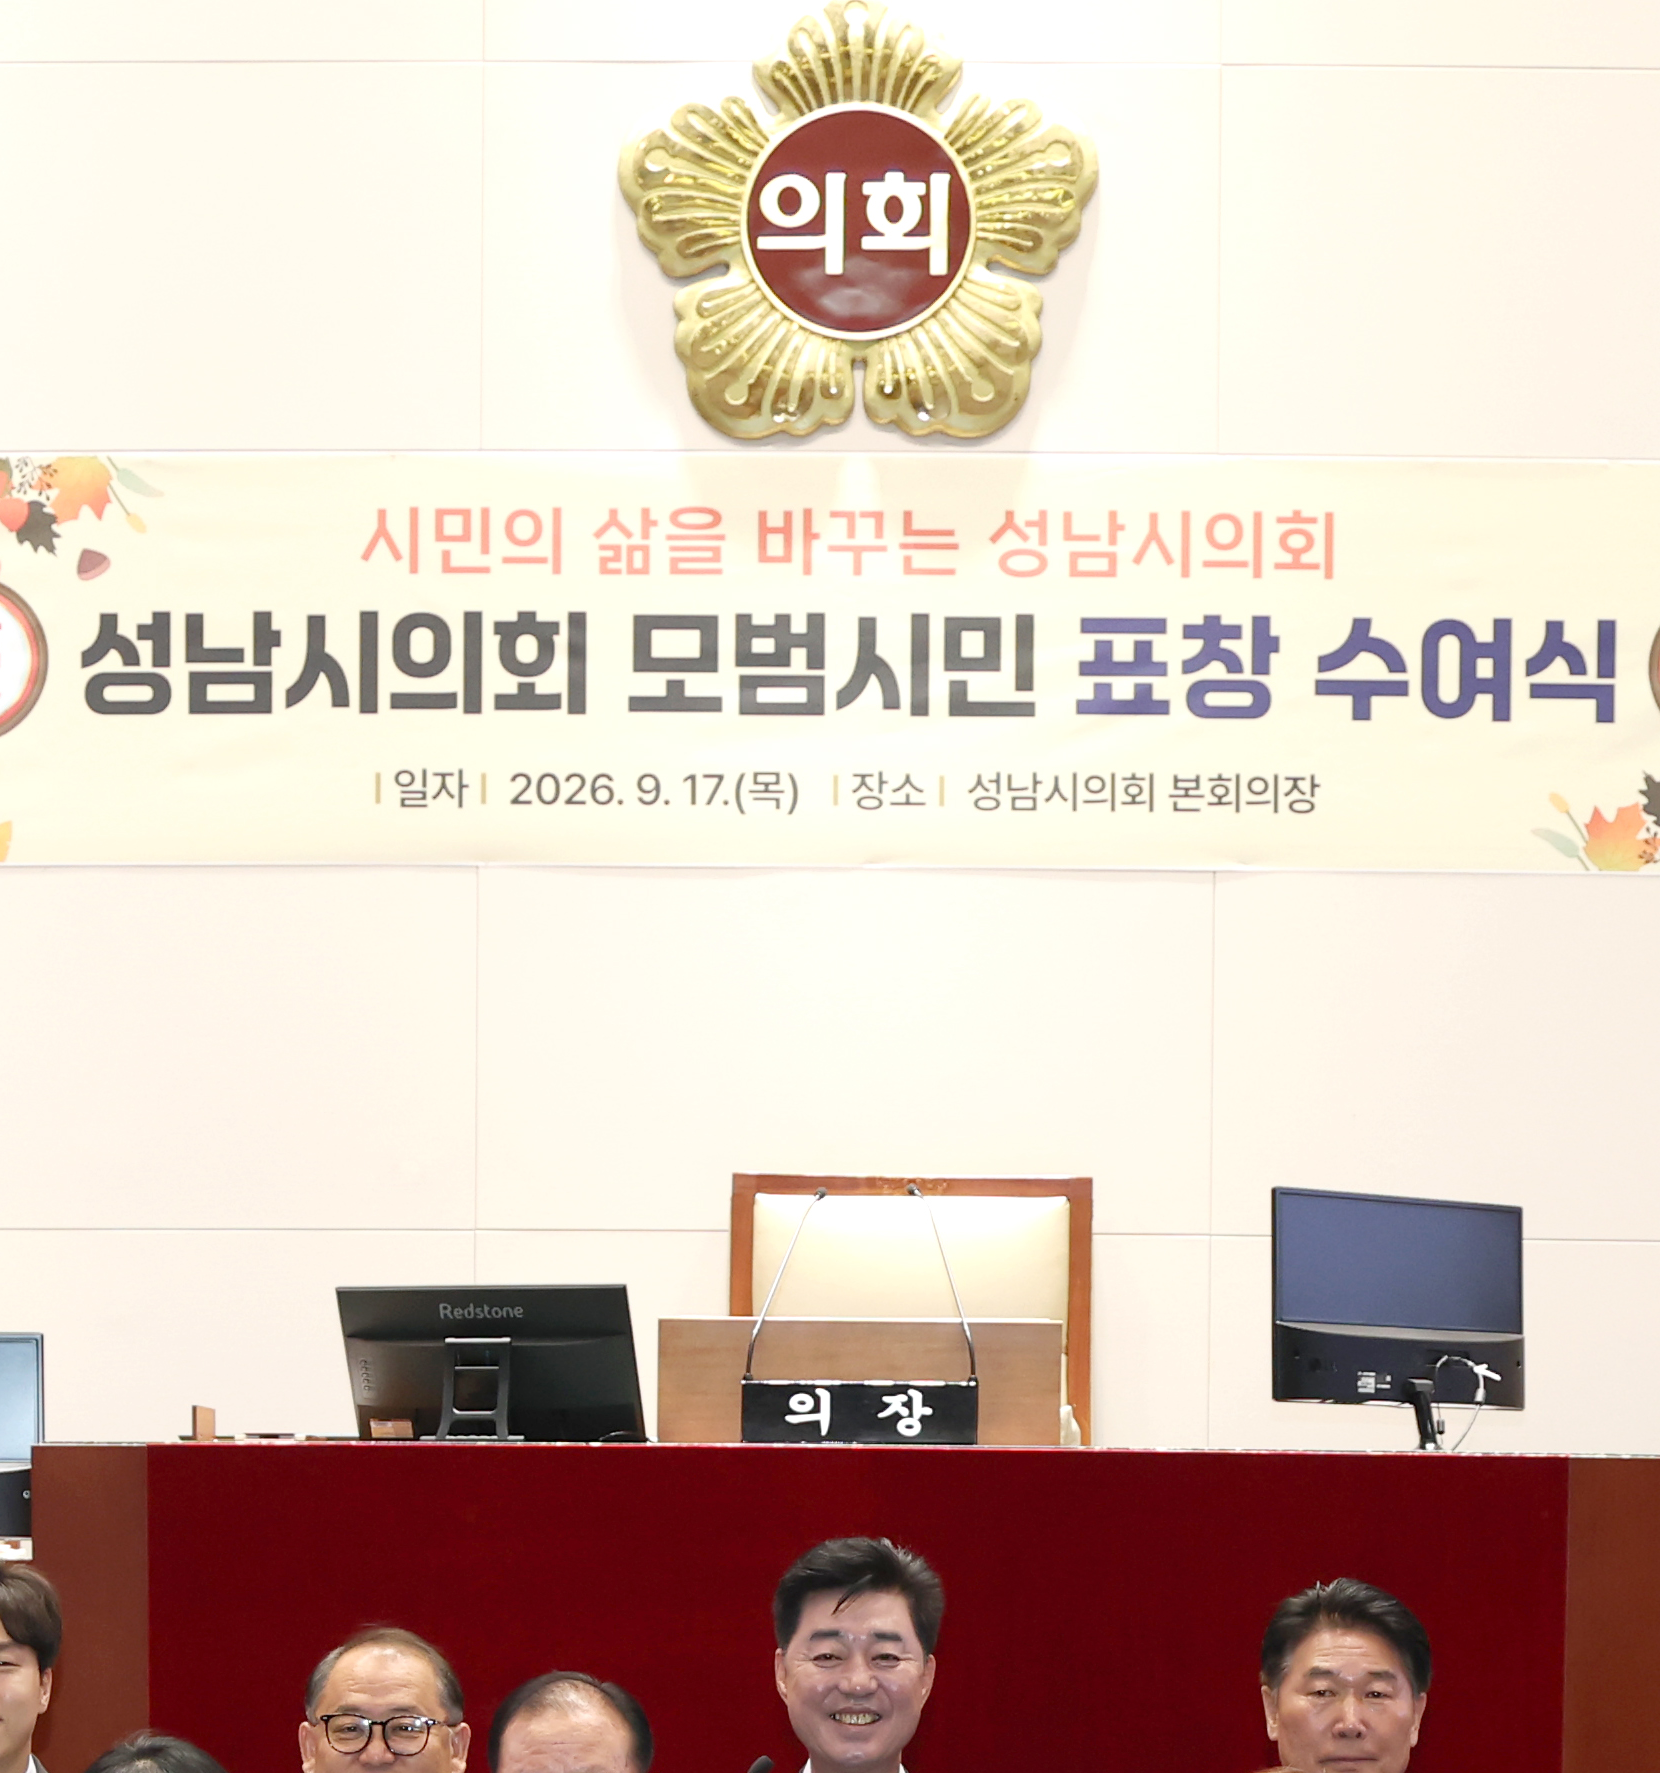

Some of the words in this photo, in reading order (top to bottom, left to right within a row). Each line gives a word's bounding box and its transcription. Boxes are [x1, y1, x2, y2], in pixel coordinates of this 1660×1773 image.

[757, 172, 951, 275] 의회
[360, 506, 562, 576] 시민의
[592, 505, 727, 576] 삶을
[756, 507, 960, 577] 바꾸는
[989, 508, 1335, 580] 성남시의회
[81, 611, 587, 716] 성남시의회
[628, 612, 1036, 718] 모범시민
[1075, 615, 1280, 719] 표창
[1314, 617, 1617, 724] 수여식
[394, 768, 469, 808] 일자
[510, 773, 624, 806] 2026.
[636, 773, 668, 806] 9.
[682, 771, 799, 814] 17.(목)
[851, 771, 926, 811] 장소
[967, 771, 1155, 812] 성남시의회
[1168, 773, 1321, 814] 본회의장
[438, 1302, 524, 1319] Redstone
[785, 1387, 934, 1438] 의장
